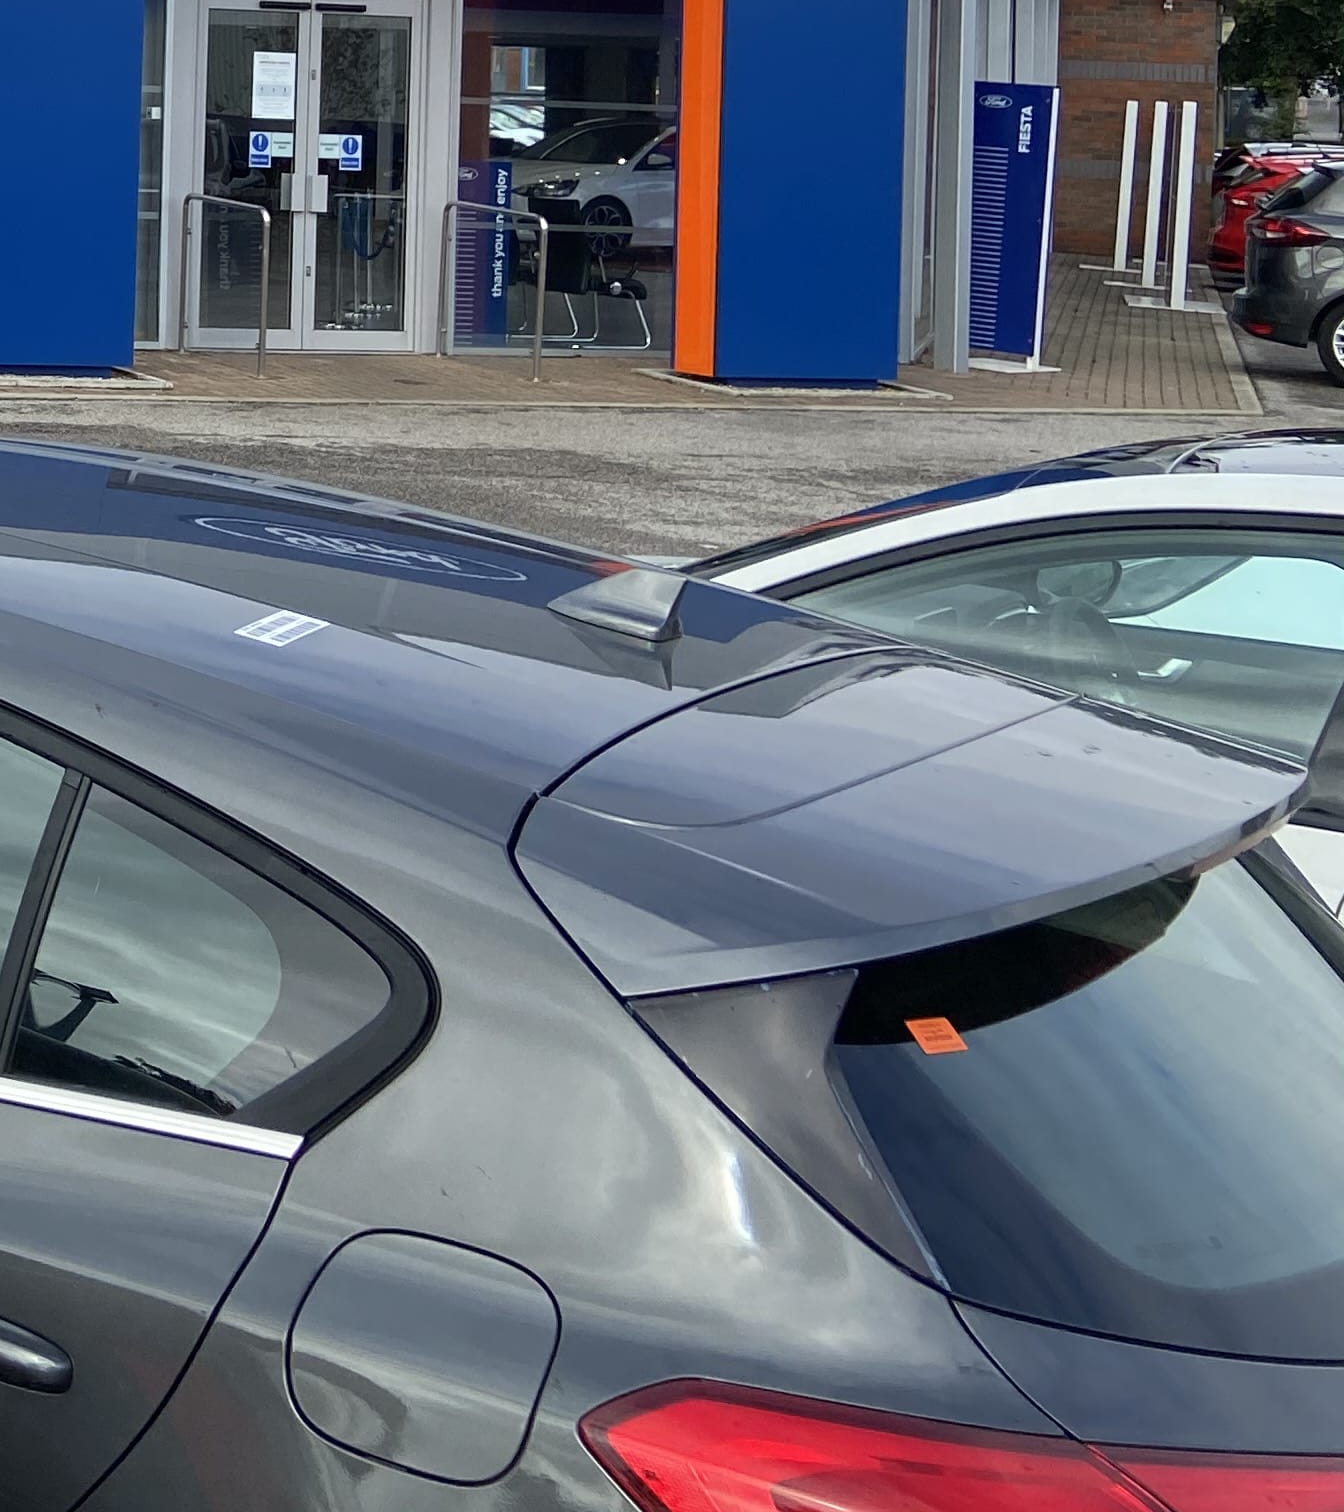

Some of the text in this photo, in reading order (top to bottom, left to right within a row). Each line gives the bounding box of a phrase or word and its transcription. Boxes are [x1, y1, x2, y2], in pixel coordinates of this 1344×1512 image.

[1018, 105, 1033, 153] FIESTA
[495, 168, 509, 205] enjoy
[494, 233, 506, 258] you
[492, 259, 503, 298] thank
